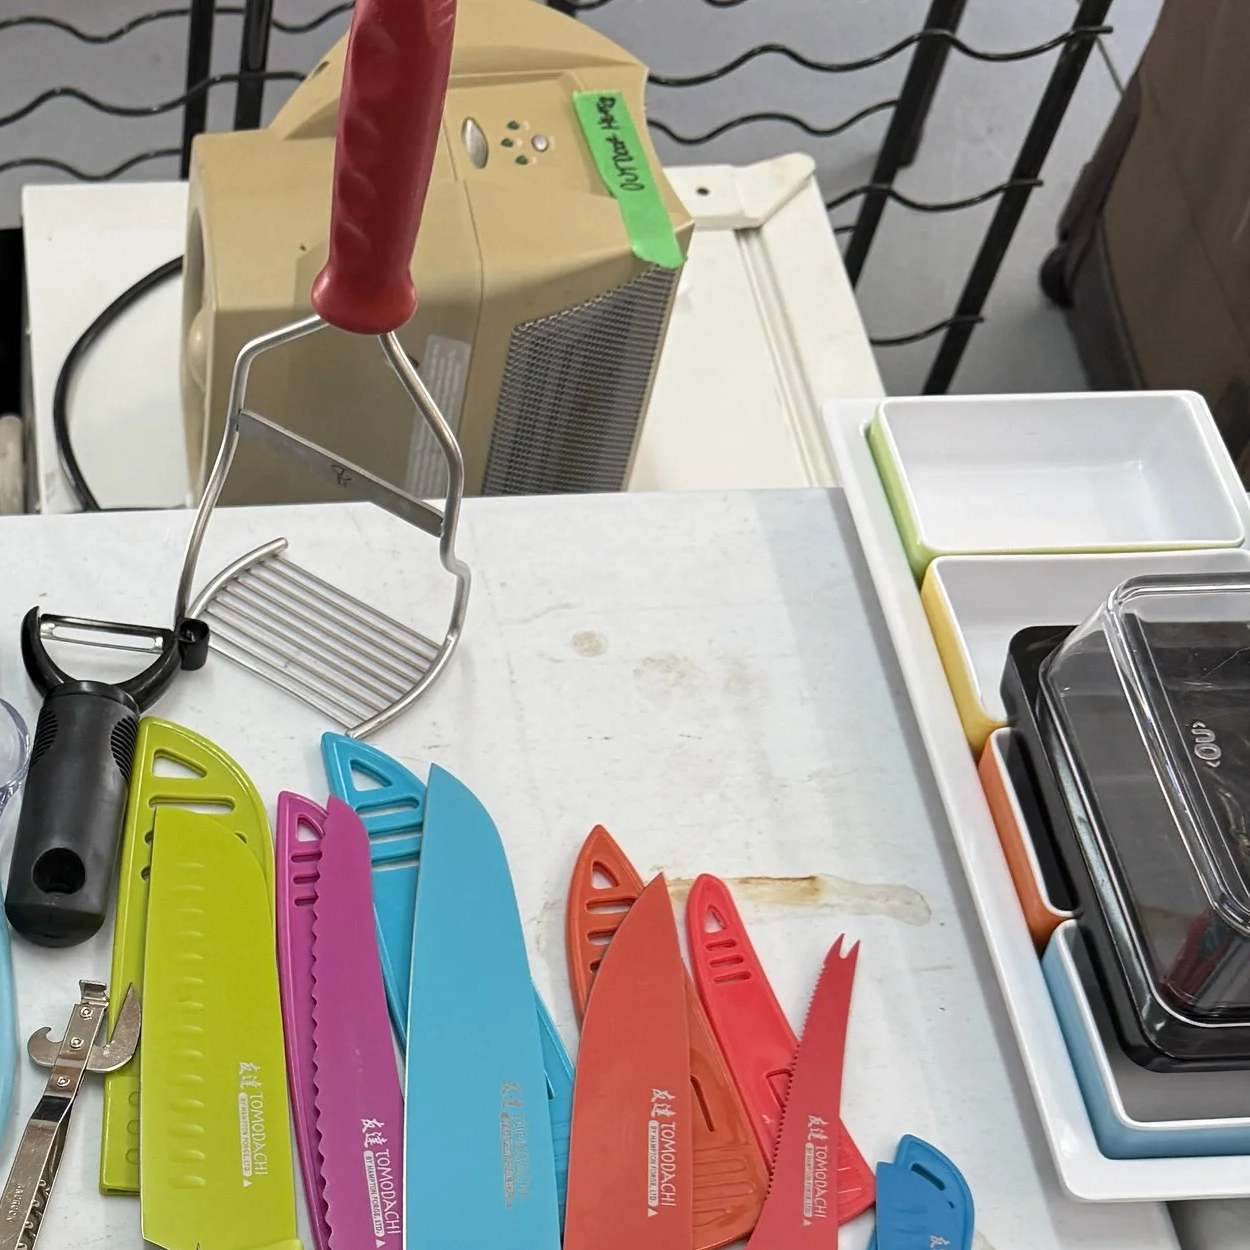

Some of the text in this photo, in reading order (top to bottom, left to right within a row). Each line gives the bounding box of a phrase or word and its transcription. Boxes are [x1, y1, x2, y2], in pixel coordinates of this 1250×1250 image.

[249, 1093, 268, 1175] TOMODACHI
[660, 1121, 676, 1206] TOMODACHI
[366, 1164, 378, 1195] HAMPTON
[375, 1148, 401, 1234] TOMODACHI
[814, 1144, 828, 1218] TOMODACHI
